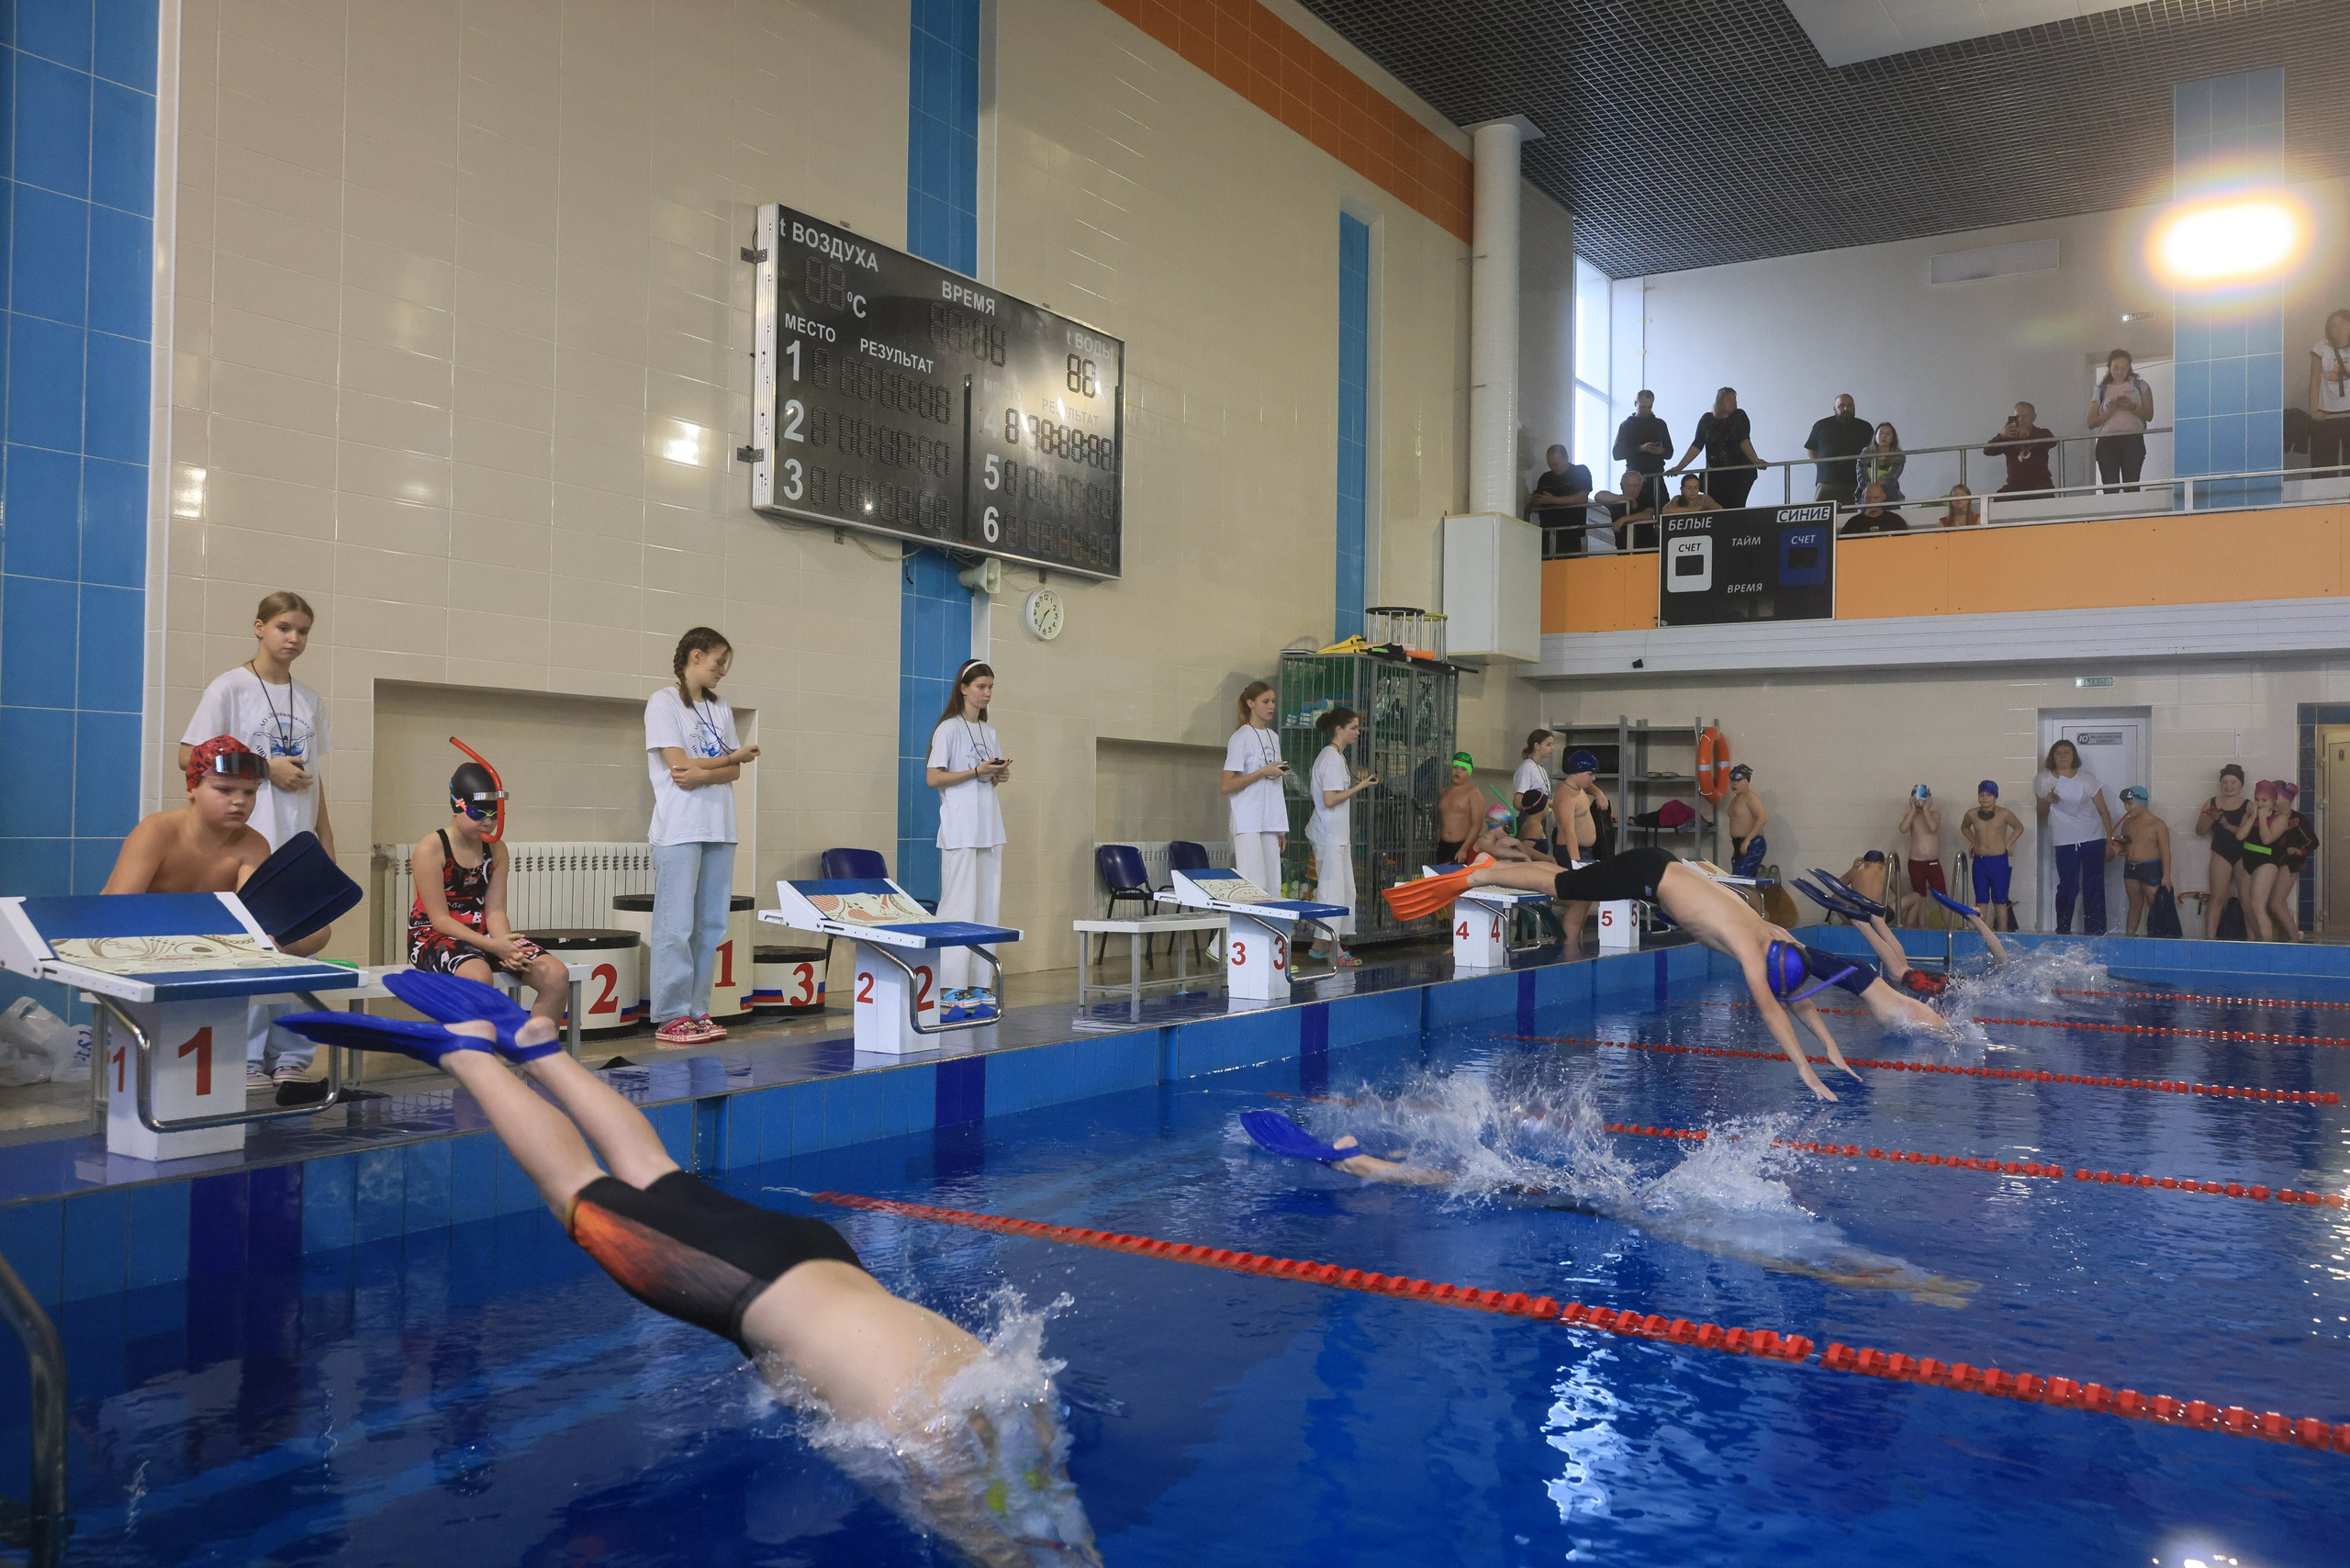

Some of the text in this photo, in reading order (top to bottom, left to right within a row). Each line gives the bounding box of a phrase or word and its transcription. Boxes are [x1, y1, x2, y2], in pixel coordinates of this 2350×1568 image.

[779, 218, 878, 273] t ВОЗДУХА
[942, 280, 995, 316] ВРЕМЯ
[785, 312, 836, 342] МЕСТО
[786, 340, 800, 382] 1
[860, 337, 934, 374] РЕЗУЛЬТАТ
[1075, 336, 1113, 364] ВОДЫ
[784, 398, 804, 442] 2
[983, 403, 1001, 439] 4
[1042, 398, 1100, 427] РЕУЛЬТАТ
[783, 458, 803, 500] 3
[983, 453, 1000, 490] 5
[983, 506, 1000, 543] 6
[1668, 516, 1713, 531] БЕЛЫЕ
[1779, 507, 1829, 522] СИНИЕ
[1678, 543, 1701, 553] СЧЕТ
[1731, 536, 1762, 547] ТАЙМ
[1791, 534, 1816, 545] СЧЕТ
[1727, 583, 1763, 594] ВРЕМЯ
[2079, 678, 2113, 687] ВЫХОД
[1456, 921, 1470, 940] 4
[1491, 915, 1501, 944] 4
[1601, 911, 1613, 927] 5
[1630, 903, 1638, 927] 5
[714, 939, 736, 988] 1
[1231, 942, 1247, 966] 3
[1273, 936, 1285, 969] 3
[588, 963, 618, 1014] 2
[789, 962, 814, 1007] 3
[856, 972, 874, 1004] 2
[915, 965, 934, 1013] 2
[113, 1047, 126, 1092] 1
[178, 1026, 213, 1096] 1
